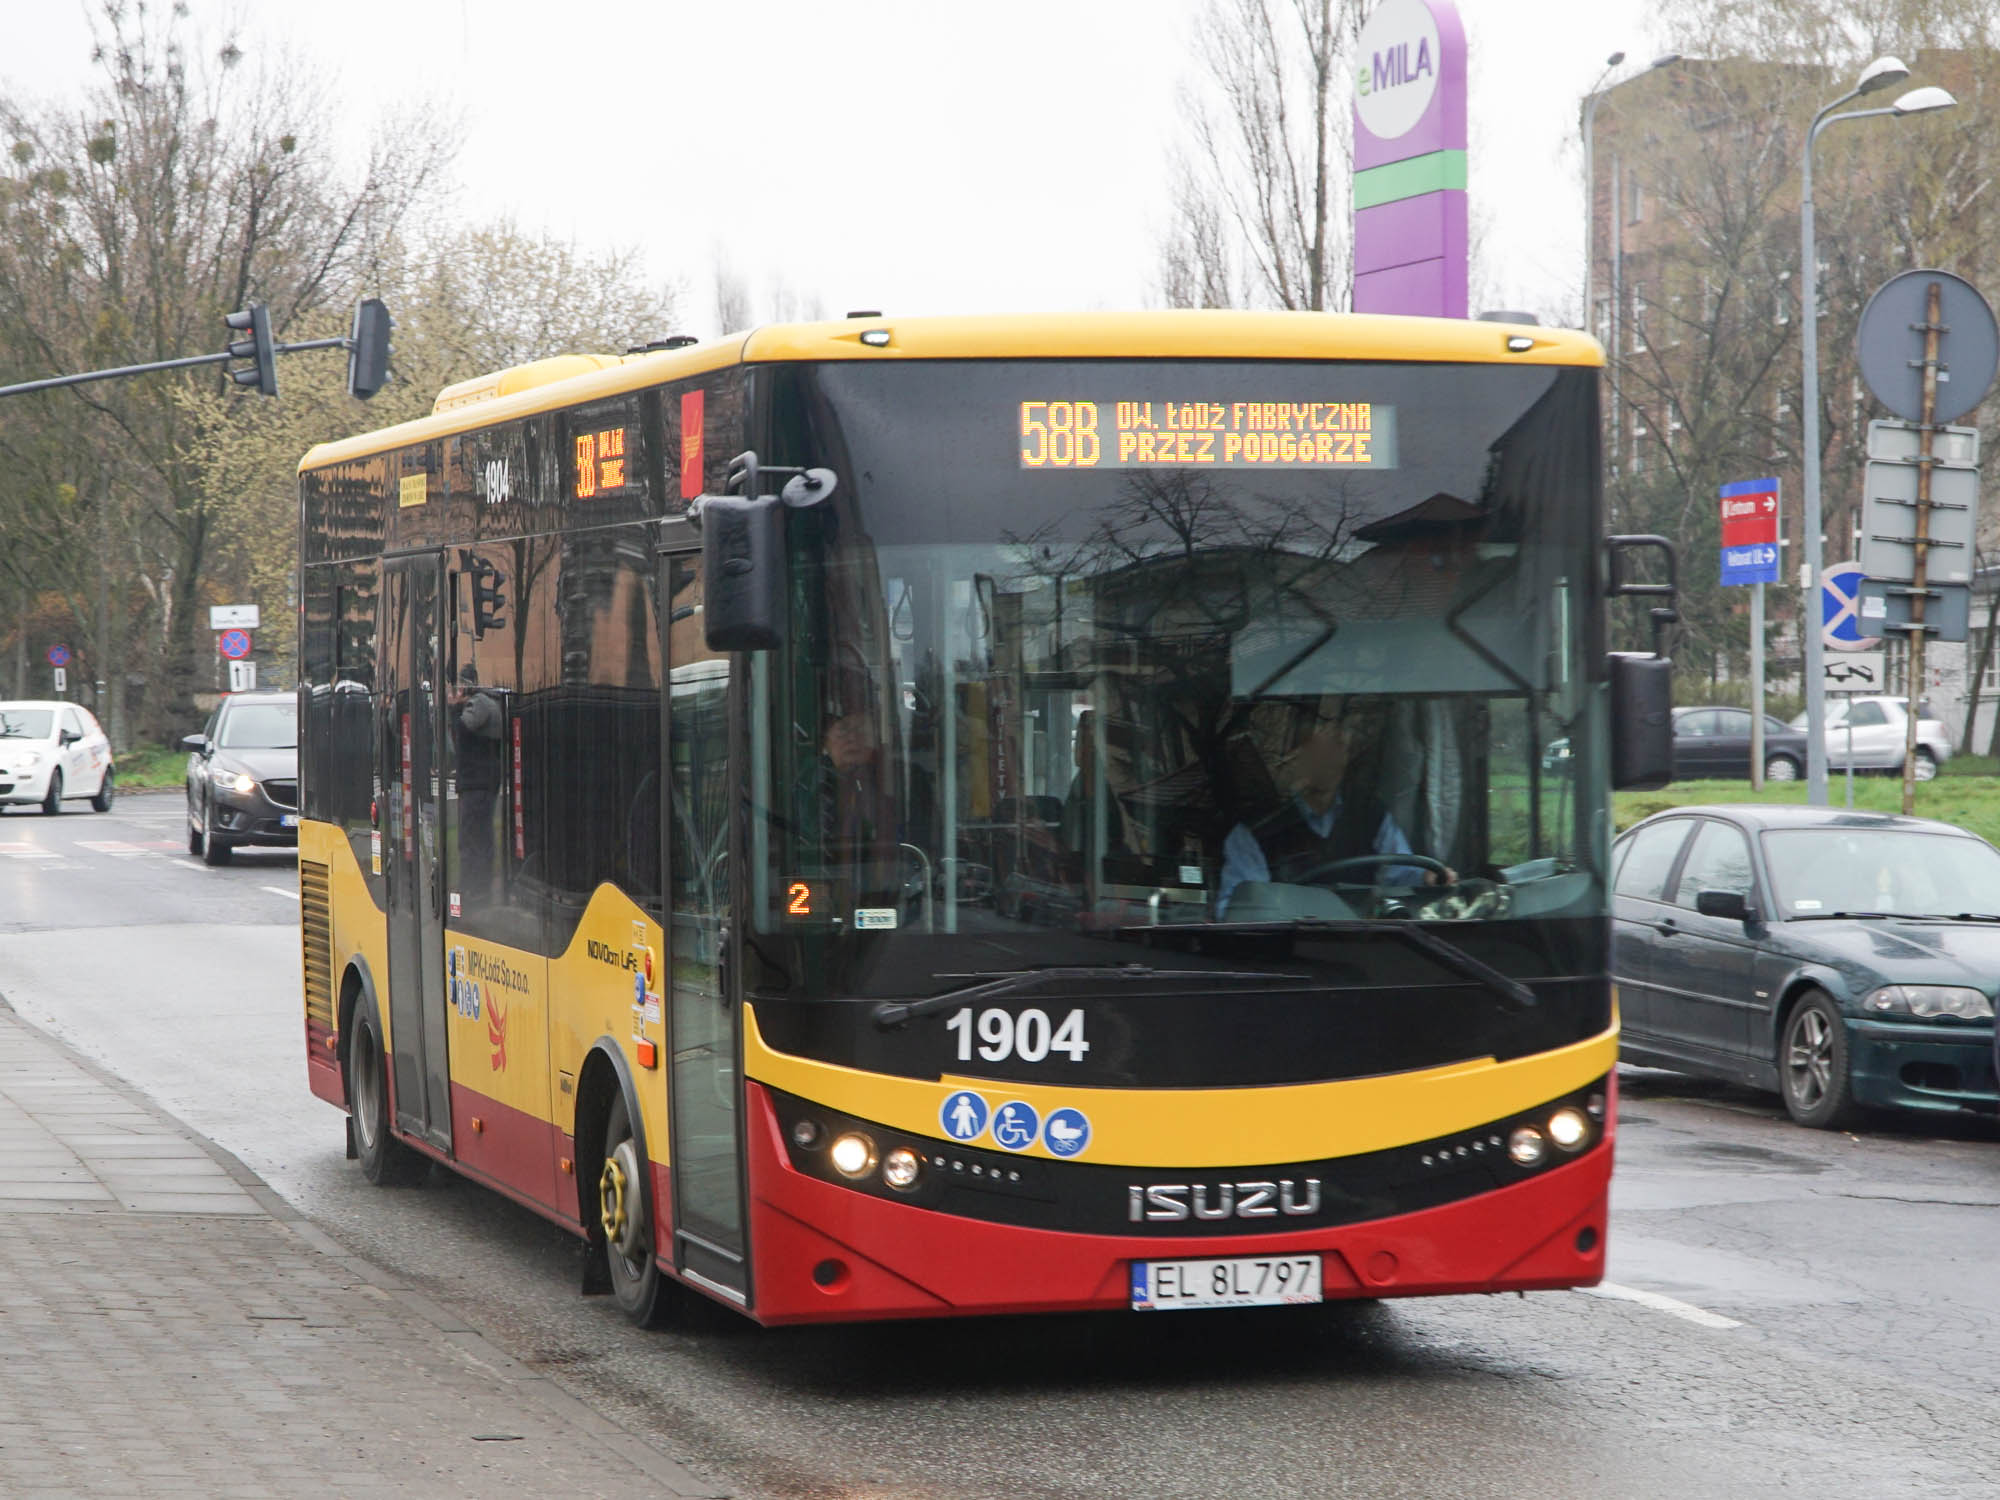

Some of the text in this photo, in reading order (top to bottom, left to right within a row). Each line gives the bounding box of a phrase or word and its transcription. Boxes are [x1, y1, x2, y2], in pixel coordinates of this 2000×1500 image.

[1358, 36, 1433, 96] eMILA
[1021, 401, 1100, 466] 58B
[1231, 402, 1371, 431] FABRYCZNA
[1119, 431, 1372, 463] PRZEZ PODGÓRZE
[485, 456, 509, 504] 1904
[789, 882, 811, 914] 2
[946, 1007, 1090, 1062] 1904
[1128, 1178, 1322, 1222] ISUZU
[1156, 1265, 1196, 1298] EL
[1211, 1260, 1312, 1296] 8L797
